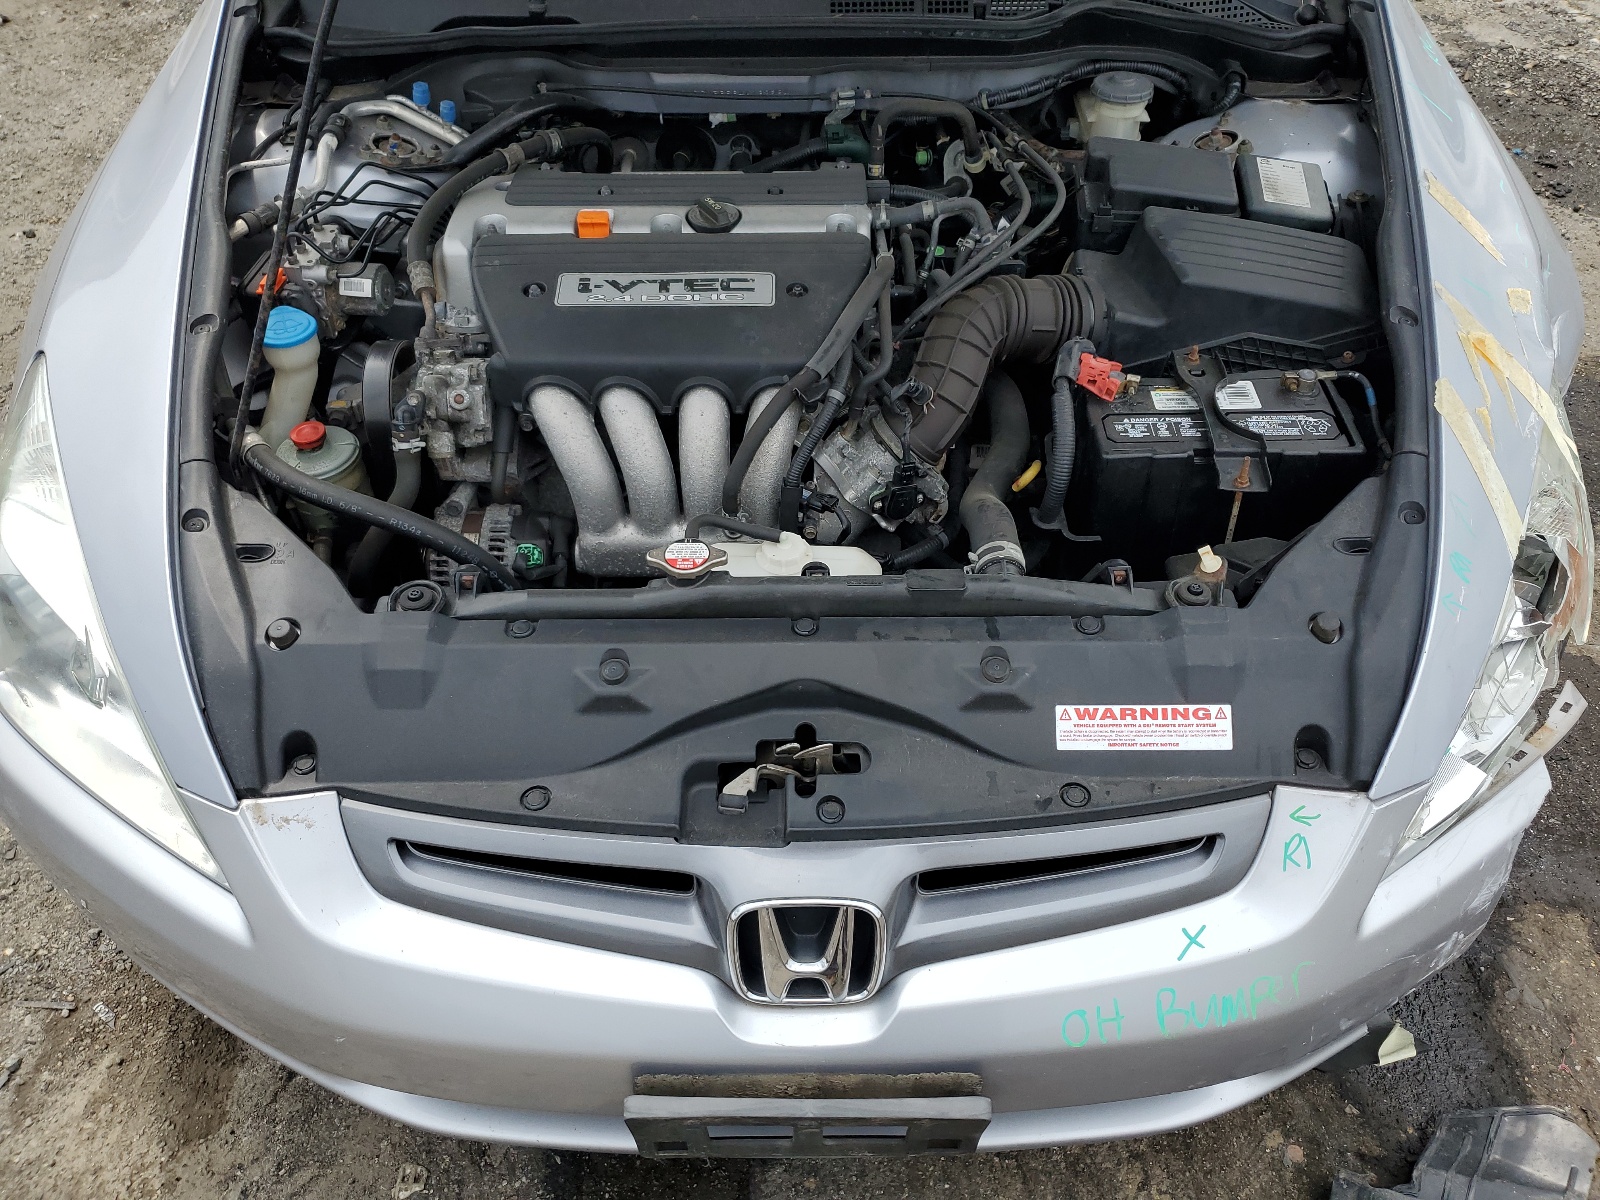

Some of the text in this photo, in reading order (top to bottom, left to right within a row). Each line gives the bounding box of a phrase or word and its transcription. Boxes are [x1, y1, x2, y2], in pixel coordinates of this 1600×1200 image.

[577, 278, 756, 293] i-VTEC
[587, 293, 745, 302] 2.4 DOHC
[1074, 707, 1212, 721] WARNING
[1061, 998, 1125, 1048] OH
